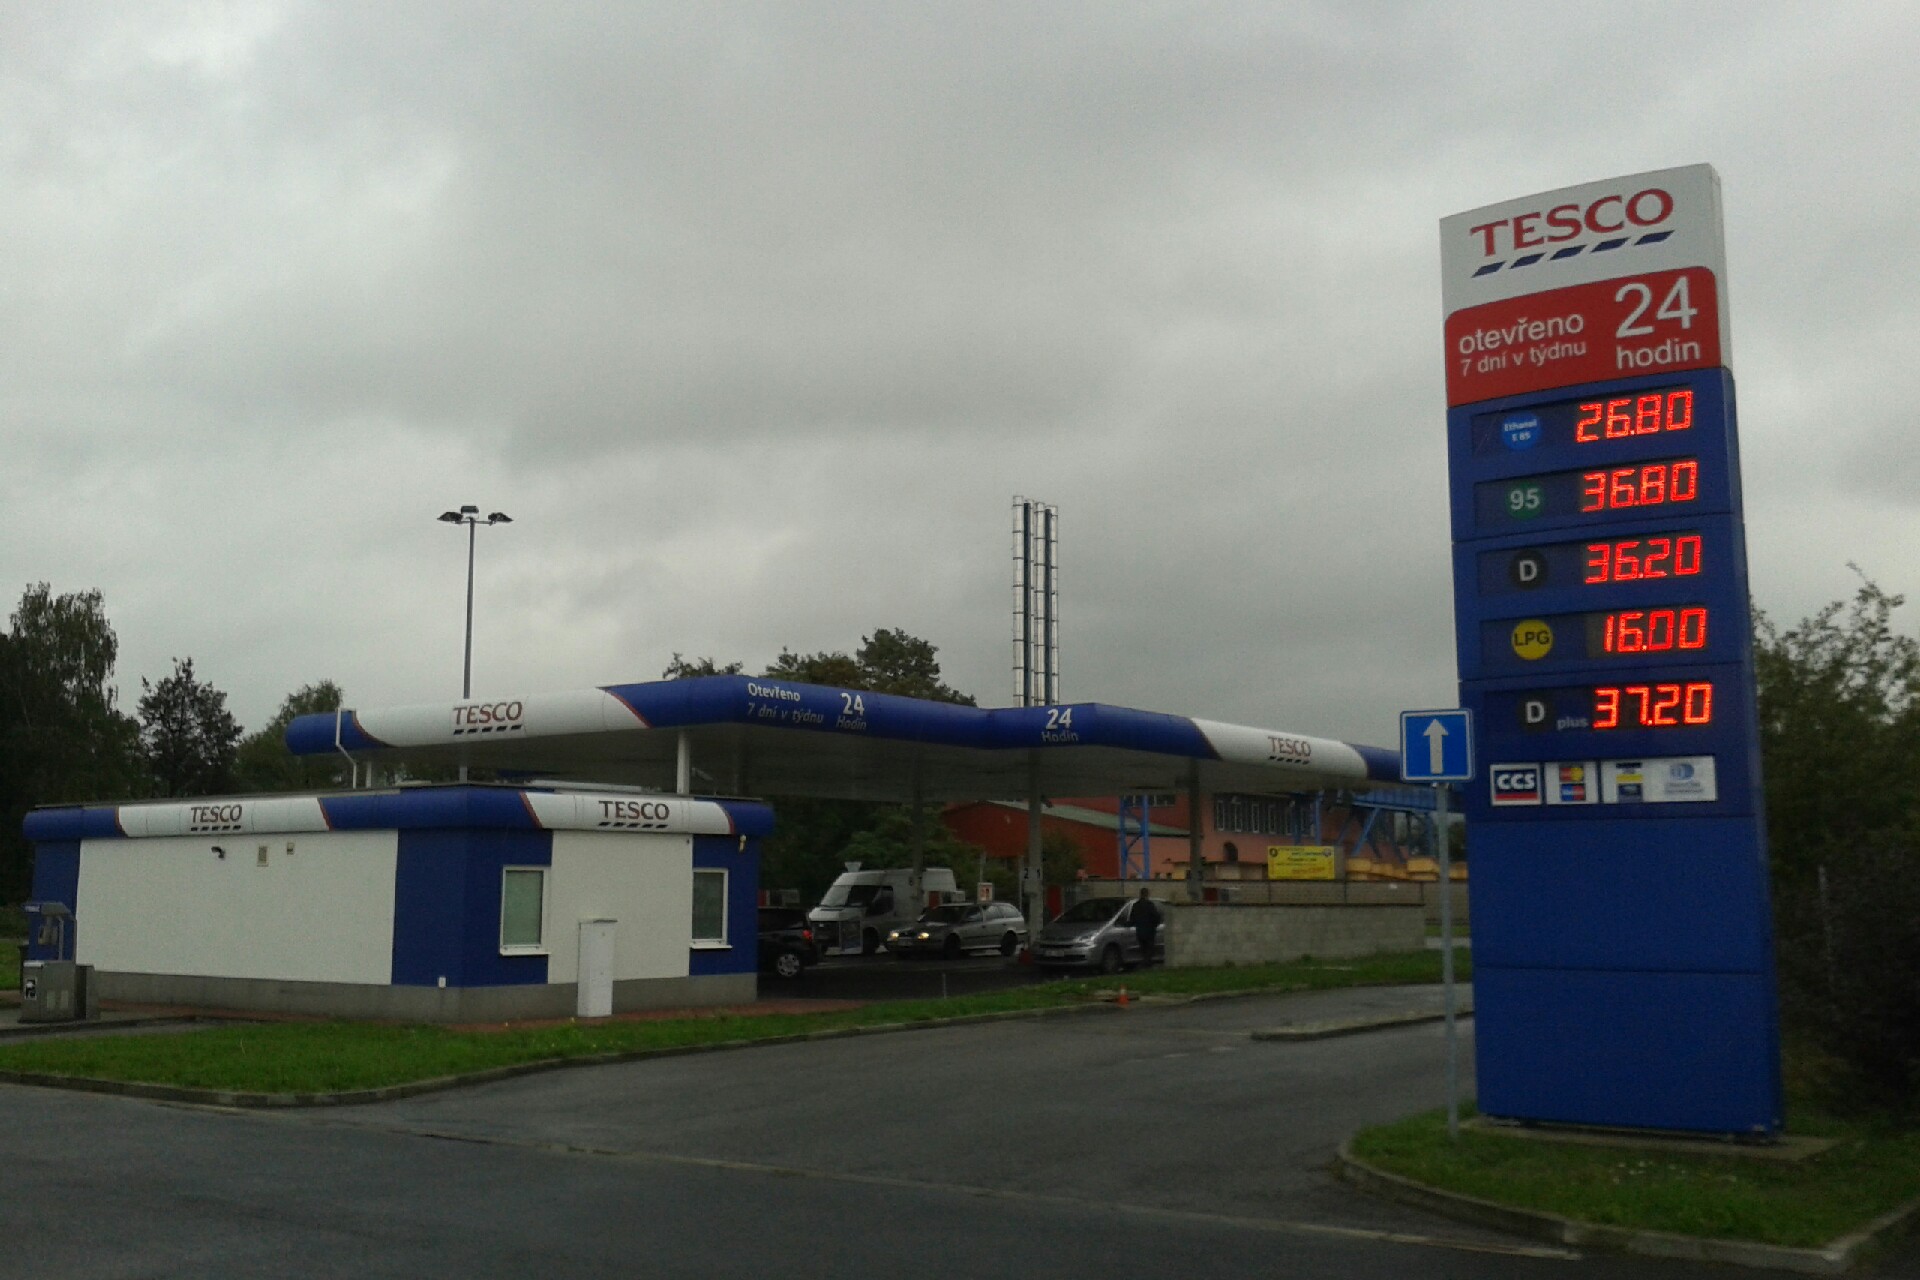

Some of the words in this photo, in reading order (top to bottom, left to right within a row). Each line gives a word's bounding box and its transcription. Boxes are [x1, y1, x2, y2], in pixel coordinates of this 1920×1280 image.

[1470, 188, 1674, 257] TESCO
[1615, 276, 1698, 338] 24
[1459, 314, 1584, 355] otevřeno
[1461, 359, 1471, 377] 7
[1477, 349, 1507, 373] dní
[1513, 353, 1524, 366] v
[1530, 341, 1587, 366] týdnu
[1616, 338, 1700, 369] hodin
[1575, 390, 1693, 443] 26.80
[1582, 460, 1698, 512] 36.80
[1510, 487, 1540, 510] 95
[1519, 560, 1537, 581] D
[1585, 535, 1701, 584] 36.20
[1513, 630, 1550, 647] LPG
[1603, 607, 1707, 653] 16.00
[747, 682, 801, 702] Otevřeno
[840, 692, 865, 716] 24
[453, 701, 523, 725] TESCO
[747, 702, 755, 716] 7
[758, 703, 777, 718] dní
[781, 710, 788, 719] v
[792, 708, 824, 725] týdnu
[1525, 702, 1545, 723] D
[1557, 716, 1589, 731] plus
[1592, 682, 1712, 729] 37.20
[836, 714, 867, 730] Hodin
[1046, 708, 1072, 729] 24
[1041, 730, 1079, 742] Hodin
[1268, 735, 1311, 757] TESCO
[1497, 773, 1535, 791] CCS
[190, 804, 242, 823] TESCO
[598, 800, 670, 820] TESCO
